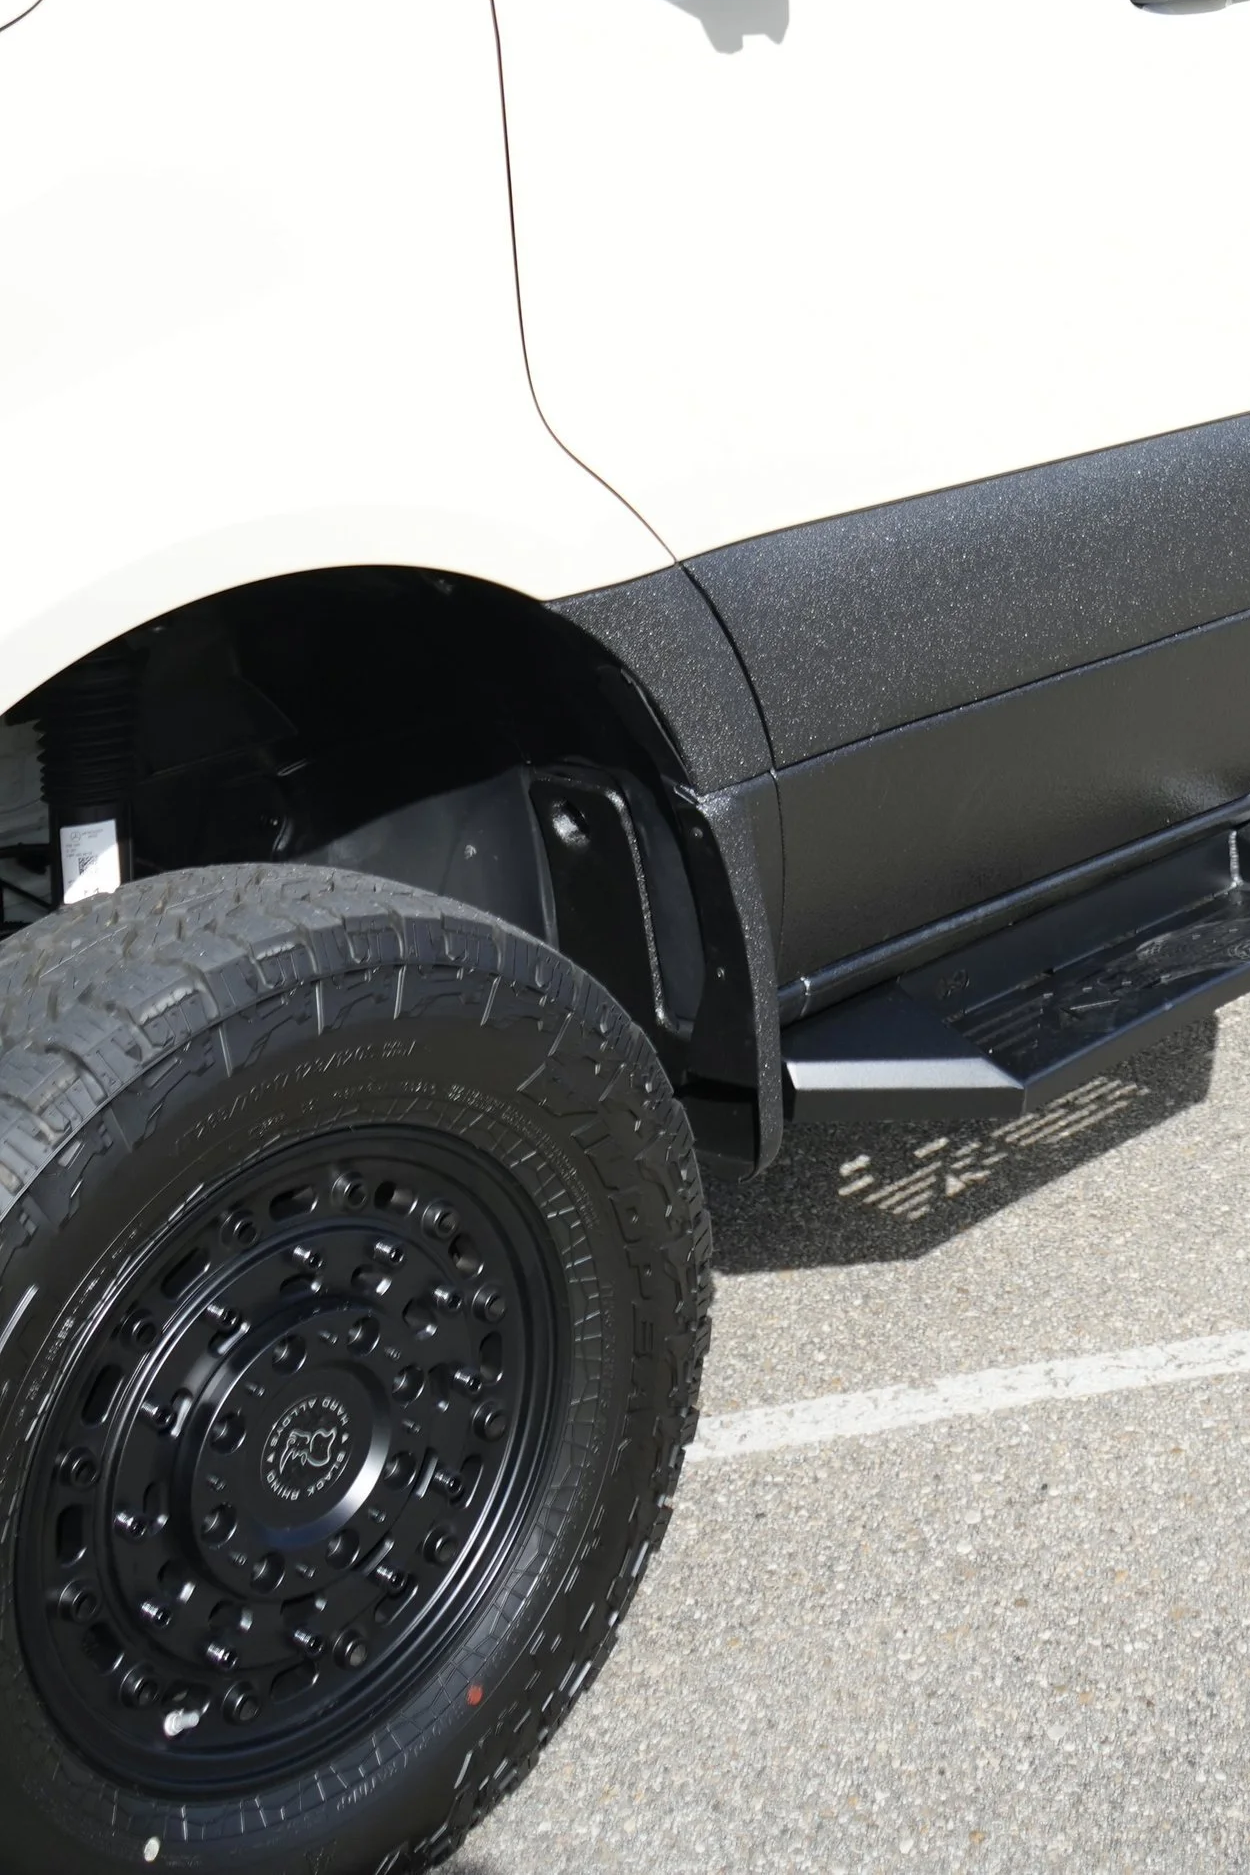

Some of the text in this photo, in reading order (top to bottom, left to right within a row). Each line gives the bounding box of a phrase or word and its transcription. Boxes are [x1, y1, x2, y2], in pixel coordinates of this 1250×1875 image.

[270, 1396, 350, 1447] HARD ALLOYS
[266, 1451, 347, 1501] BLACK RHINO
